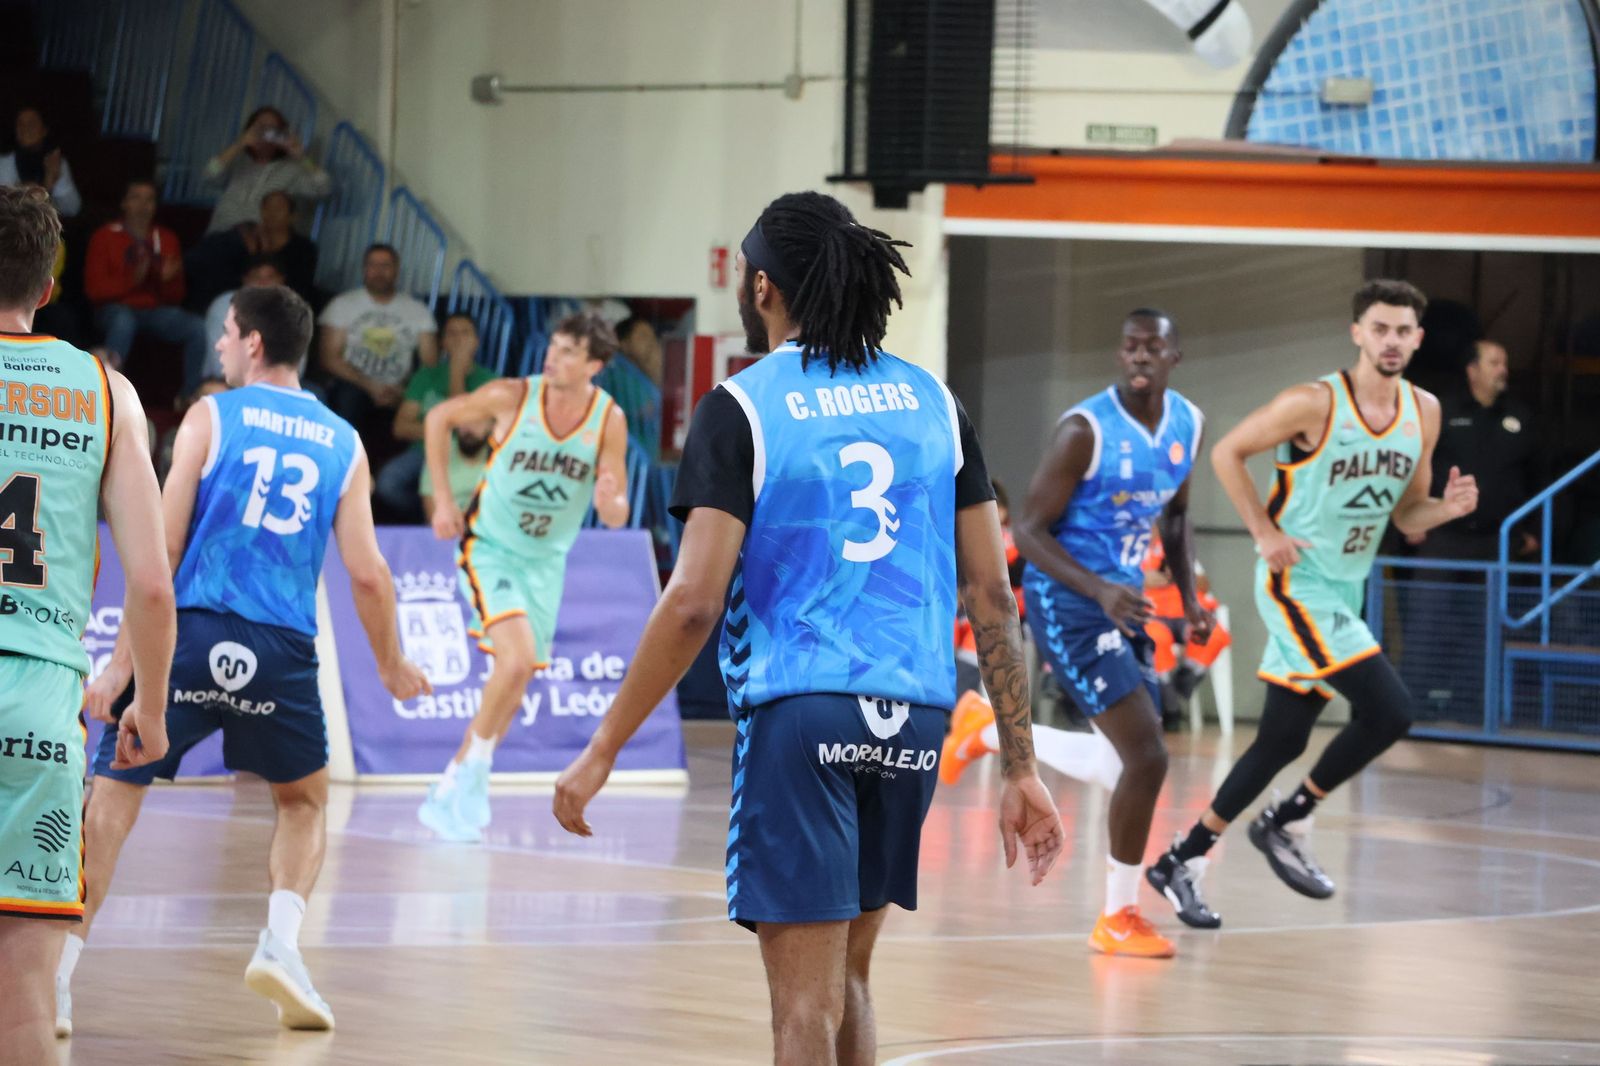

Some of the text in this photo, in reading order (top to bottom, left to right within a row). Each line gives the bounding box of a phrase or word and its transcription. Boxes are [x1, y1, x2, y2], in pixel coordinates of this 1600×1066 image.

[4, 362, 60, 374] Baleares
[785, 383, 920, 420] C. ROGERS
[242, 406, 335, 449] MARTÍNEZ
[0, 448, 89, 470] L TECHNOLOGY
[509, 450, 591, 483] PALMER
[1329, 450, 1414, 486] PALMER
[242, 445, 320, 536] 13
[839, 441, 900, 562] 3
[519, 511, 552, 538] 22
[1342, 525, 1377, 554] 25
[479, 650, 625, 681] Jta de
[173, 689, 277, 715] MORALEJO
[392, 687, 483, 720] Castil
[521, 692, 542, 726] y
[0, 731, 68, 764] risa
[818, 743, 938, 772] MORALEJO
[4, 860, 72, 884] ALUA
